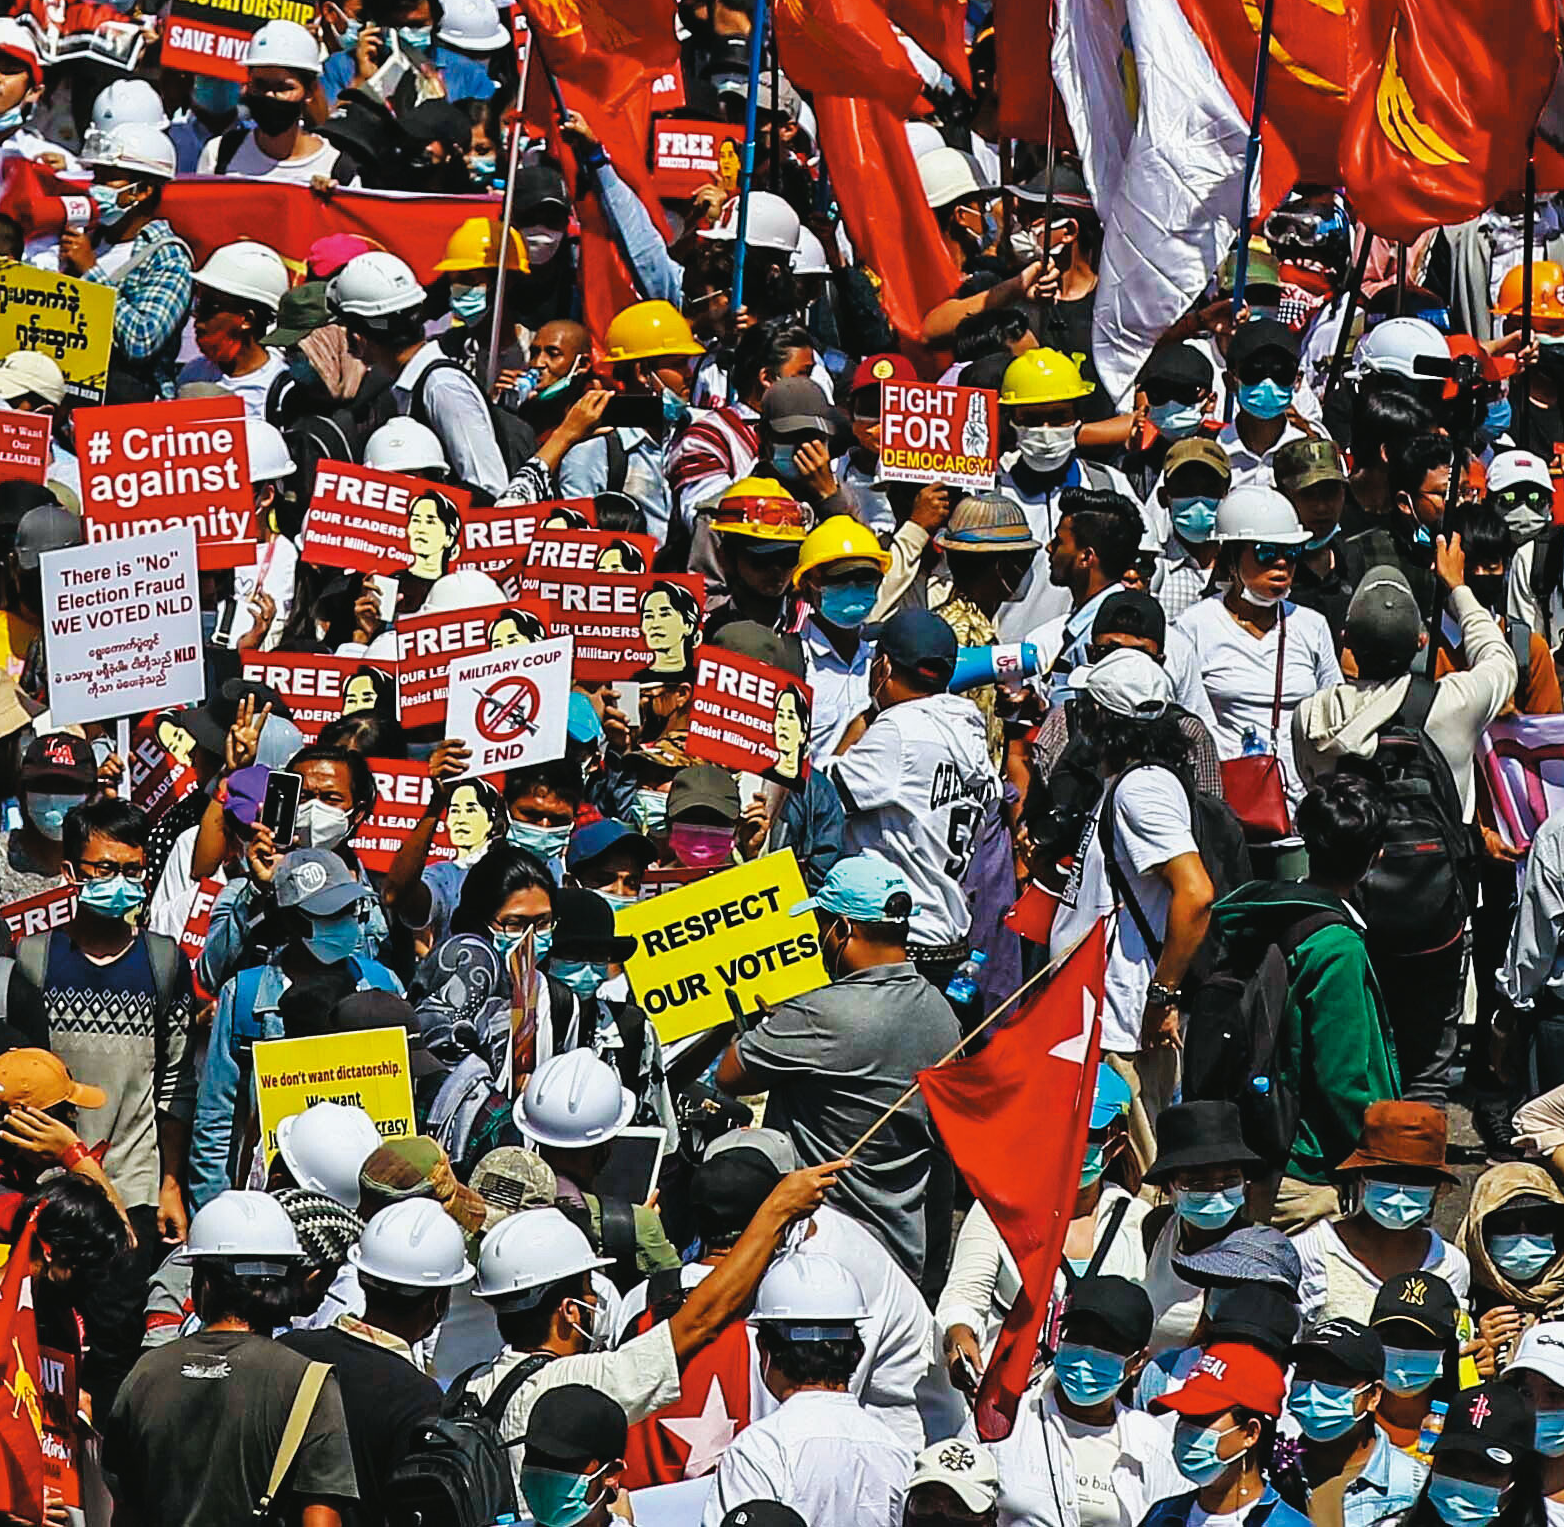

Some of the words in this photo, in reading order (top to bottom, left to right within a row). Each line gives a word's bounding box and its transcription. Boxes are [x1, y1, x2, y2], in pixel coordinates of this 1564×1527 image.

[169, 24, 214, 54] SAVE
[657, 133, 713, 158] FREE
[884, 385, 958, 417] FIGHT
[11, 438, 32, 451] Our
[18, 425, 43, 439] Want
[87, 431, 112, 465] #
[121, 426, 234, 463] Crime
[884, 413, 952, 452] FOR
[883, 448, 994, 478] DEMOCARCY!
[88, 458, 242, 509] against
[312, 472, 411, 514] FREE
[309, 509, 346, 527] OUR
[347, 516, 407, 540] LEADERS
[305, 529, 344, 549] Resist
[345, 537, 386, 560] Military
[527, 539, 599, 571] FREE
[60, 566, 112, 588] There
[116, 561, 132, 578] is
[135, 551, 180, 573] "No"
[57, 587, 130, 613] Election
[134, 573, 186, 598] Fraud
[51, 615, 83, 637] WE
[86, 603, 151, 630] VOTED
[156, 595, 194, 618] NLD
[573, 623, 641, 639] LEADERS
[173, 645, 197, 664] NLD
[397, 618, 486, 662] FREE
[242, 664, 341, 697] FREE
[398, 669, 428, 685] OUR
[458, 654, 520, 683] MILITARY
[522, 649, 564, 672] COUP
[696, 658, 777, 709] FREE
[693, 699, 720, 717] OUR
[720, 707, 774, 734] LEADERS
[482, 741, 525, 767] END
[642, 886, 782, 957] RESPECT
[642, 974, 708, 1016] OUR
[714, 933, 821, 987] VOTES
[259, 1073, 279, 1090] We
[279, 1069, 307, 1087] don't
[307, 1070, 336, 1085] want
[336, 1060, 402, 1084] dictatorship.
